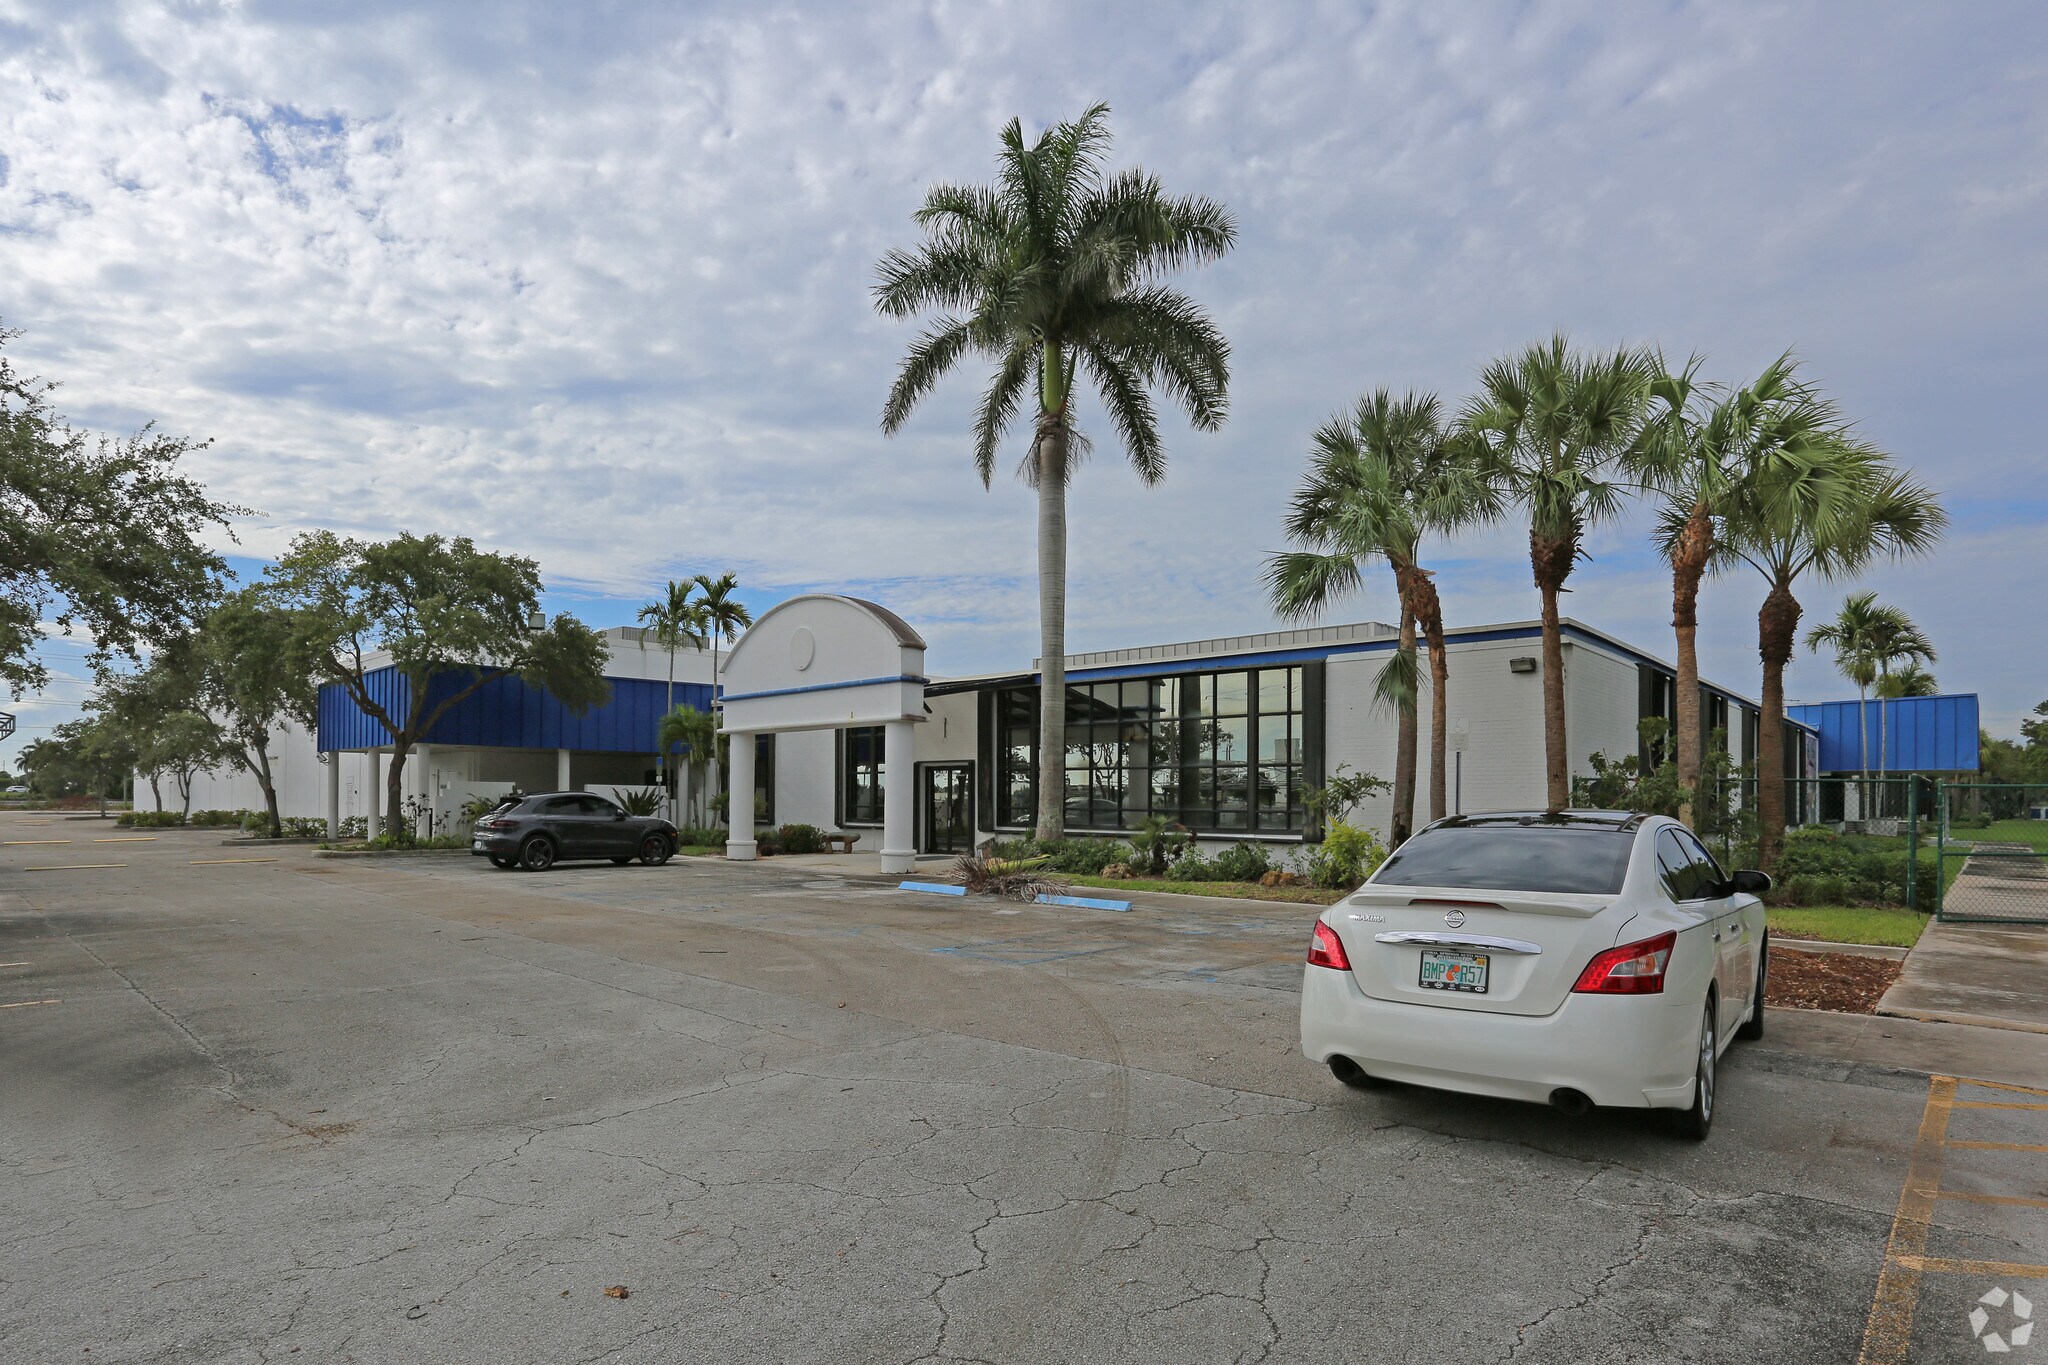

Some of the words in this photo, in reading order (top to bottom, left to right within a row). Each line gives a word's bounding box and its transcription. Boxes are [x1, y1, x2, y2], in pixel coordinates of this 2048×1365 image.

[1348, 914, 1385, 923] MAXIMA
[1423, 961, 1446, 980] BMP
[1460, 965, 1483, 984] R57
